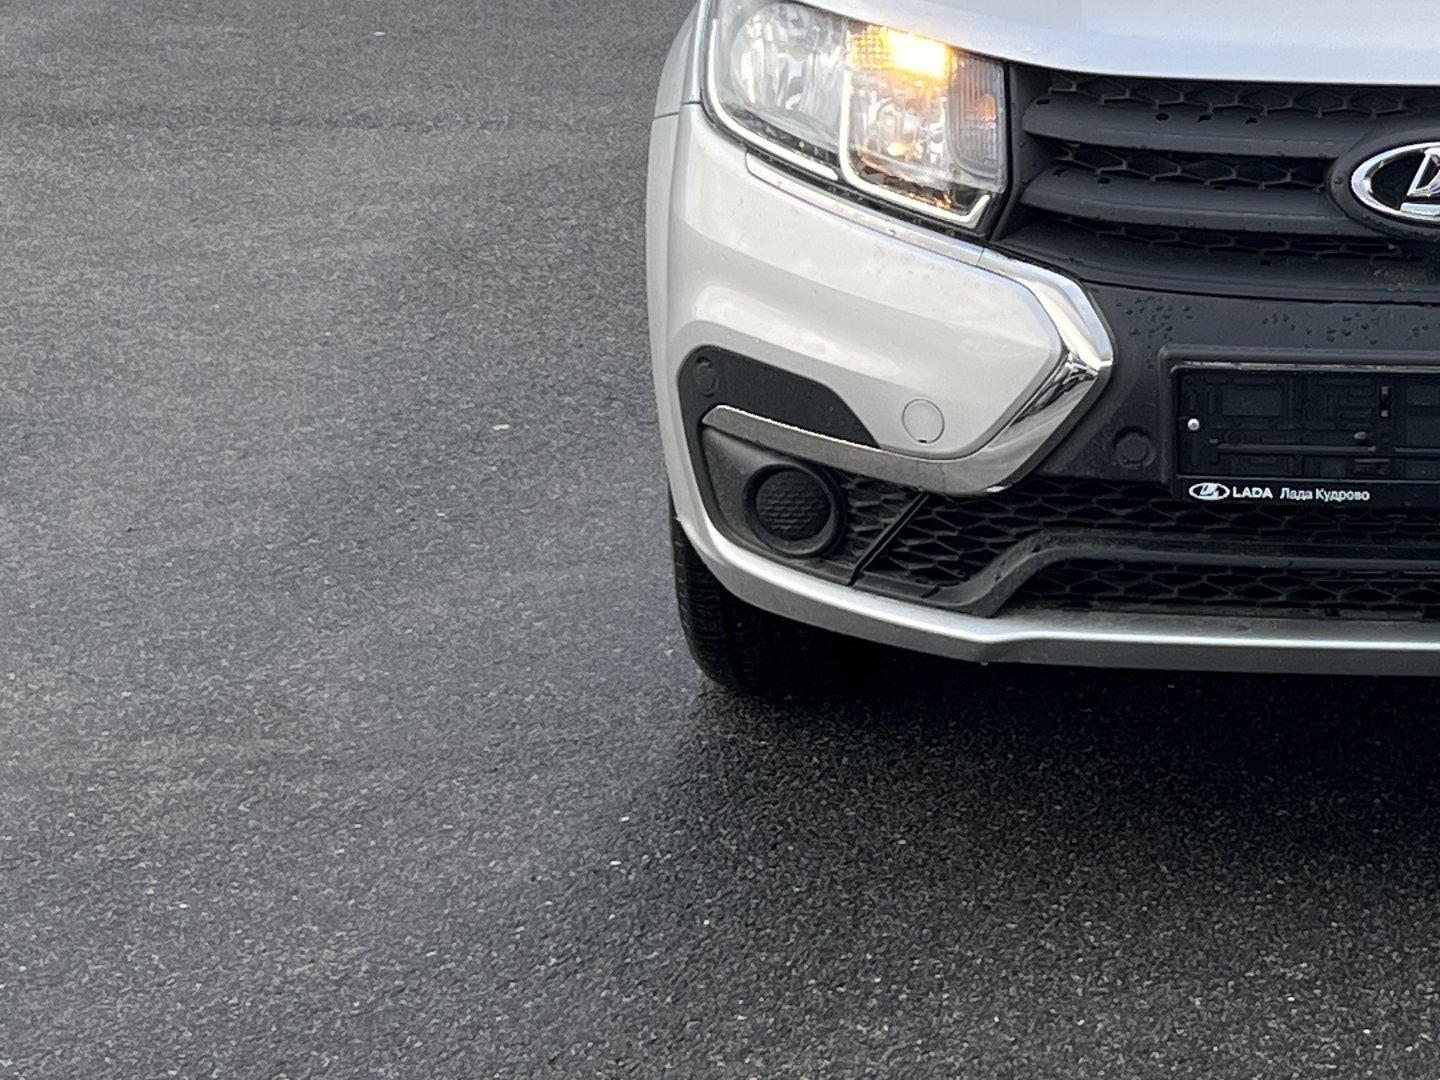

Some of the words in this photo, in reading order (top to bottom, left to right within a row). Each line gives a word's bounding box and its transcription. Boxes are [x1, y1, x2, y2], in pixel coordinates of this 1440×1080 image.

[1232, 486, 1273, 499] LADA
[1280, 487, 1313, 501] Лада
[1315, 488, 1370, 502] Кудрово
